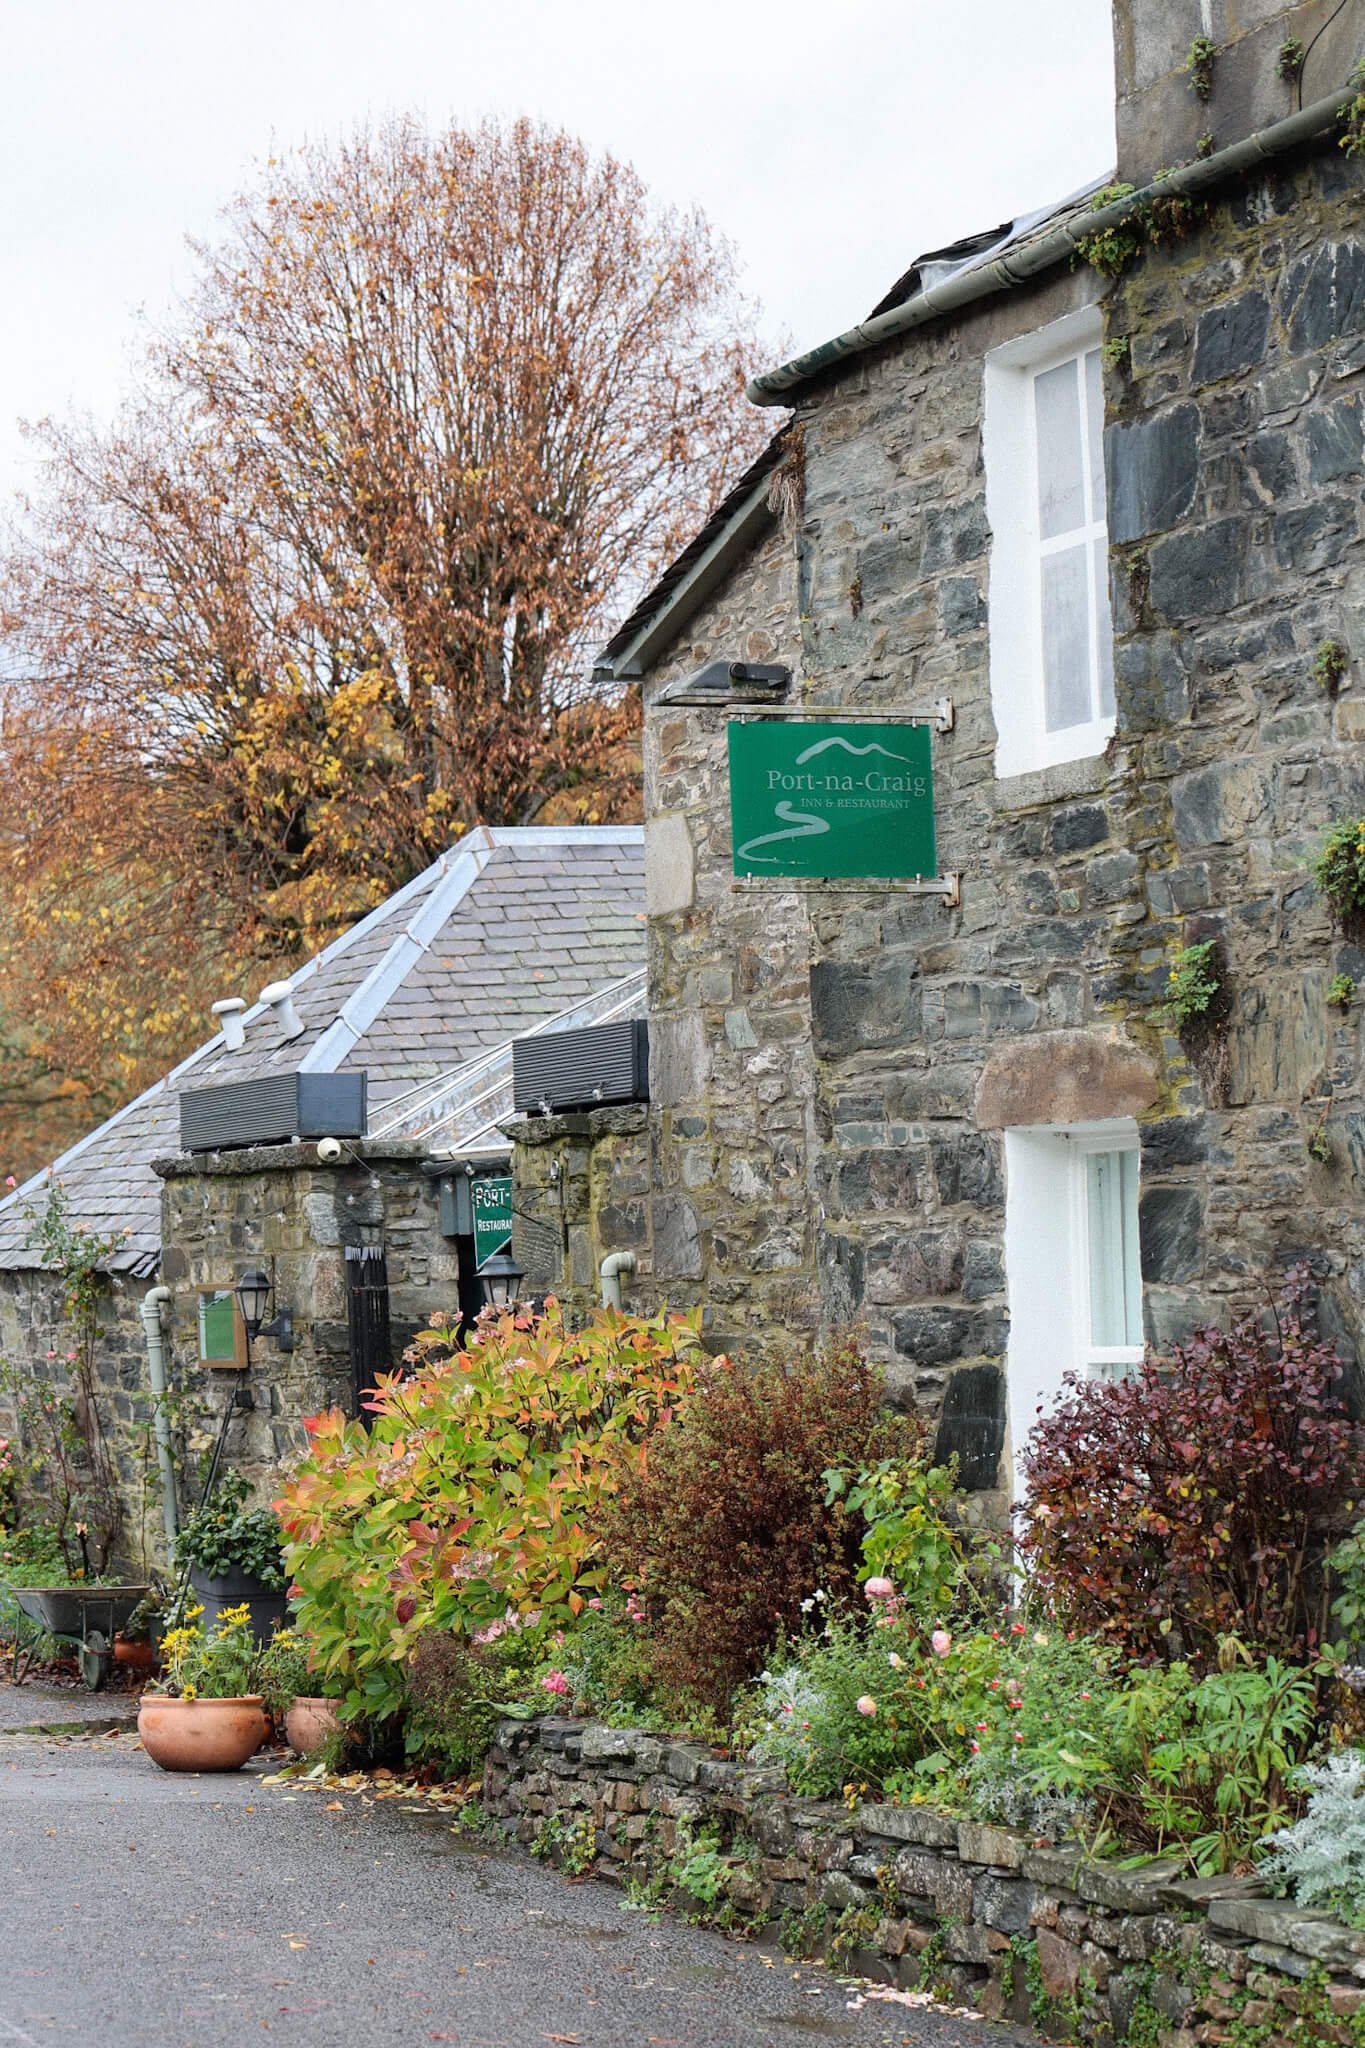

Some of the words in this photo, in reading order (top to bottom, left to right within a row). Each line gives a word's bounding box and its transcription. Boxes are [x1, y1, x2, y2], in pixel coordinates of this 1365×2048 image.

[767, 770, 926, 797] Port-na-Craig
[801, 798, 823, 808] INN
[825, 799, 834, 808] &
[837, 799, 910, 809] RESTAURANT
